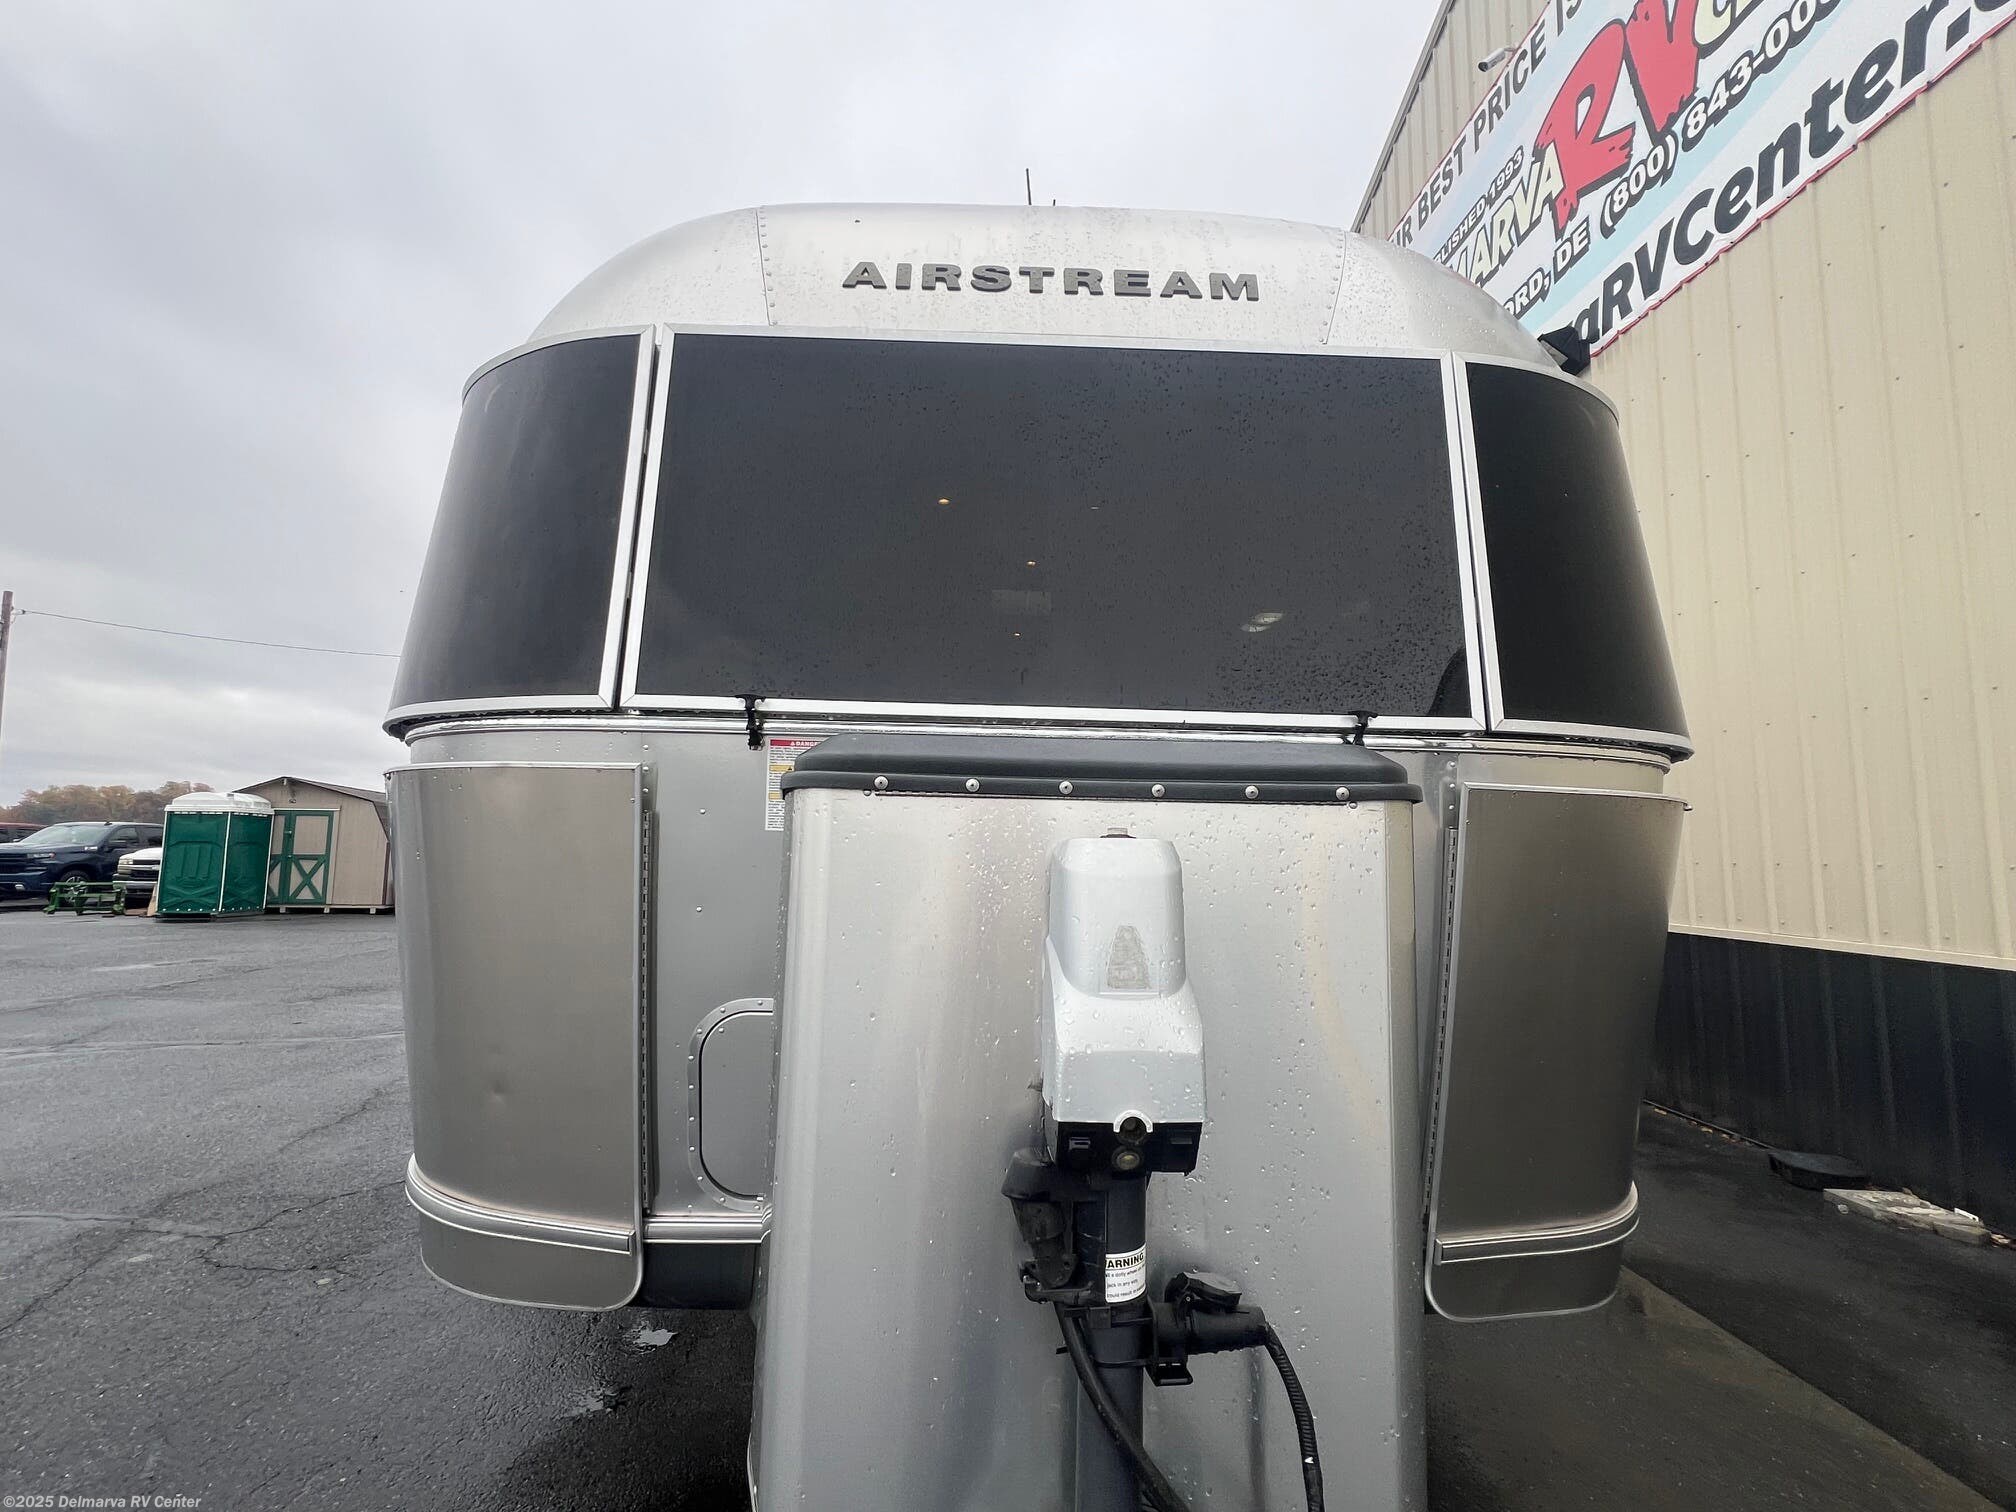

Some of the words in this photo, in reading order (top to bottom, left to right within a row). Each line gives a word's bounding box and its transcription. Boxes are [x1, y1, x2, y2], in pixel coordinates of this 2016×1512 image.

[1417, 137, 1467, 231] BEST
[1473, 18, 1547, 153] PRICE
[1486, 146, 1524, 206] 1993
[1532, 0, 1699, 241] RV
[1553, 217, 1588, 282] DE
[1601, 130, 1679, 238] (800)
[1682, 0, 1834, 150] 843-00
[842, 261, 1260, 301] AIRSTREAM
